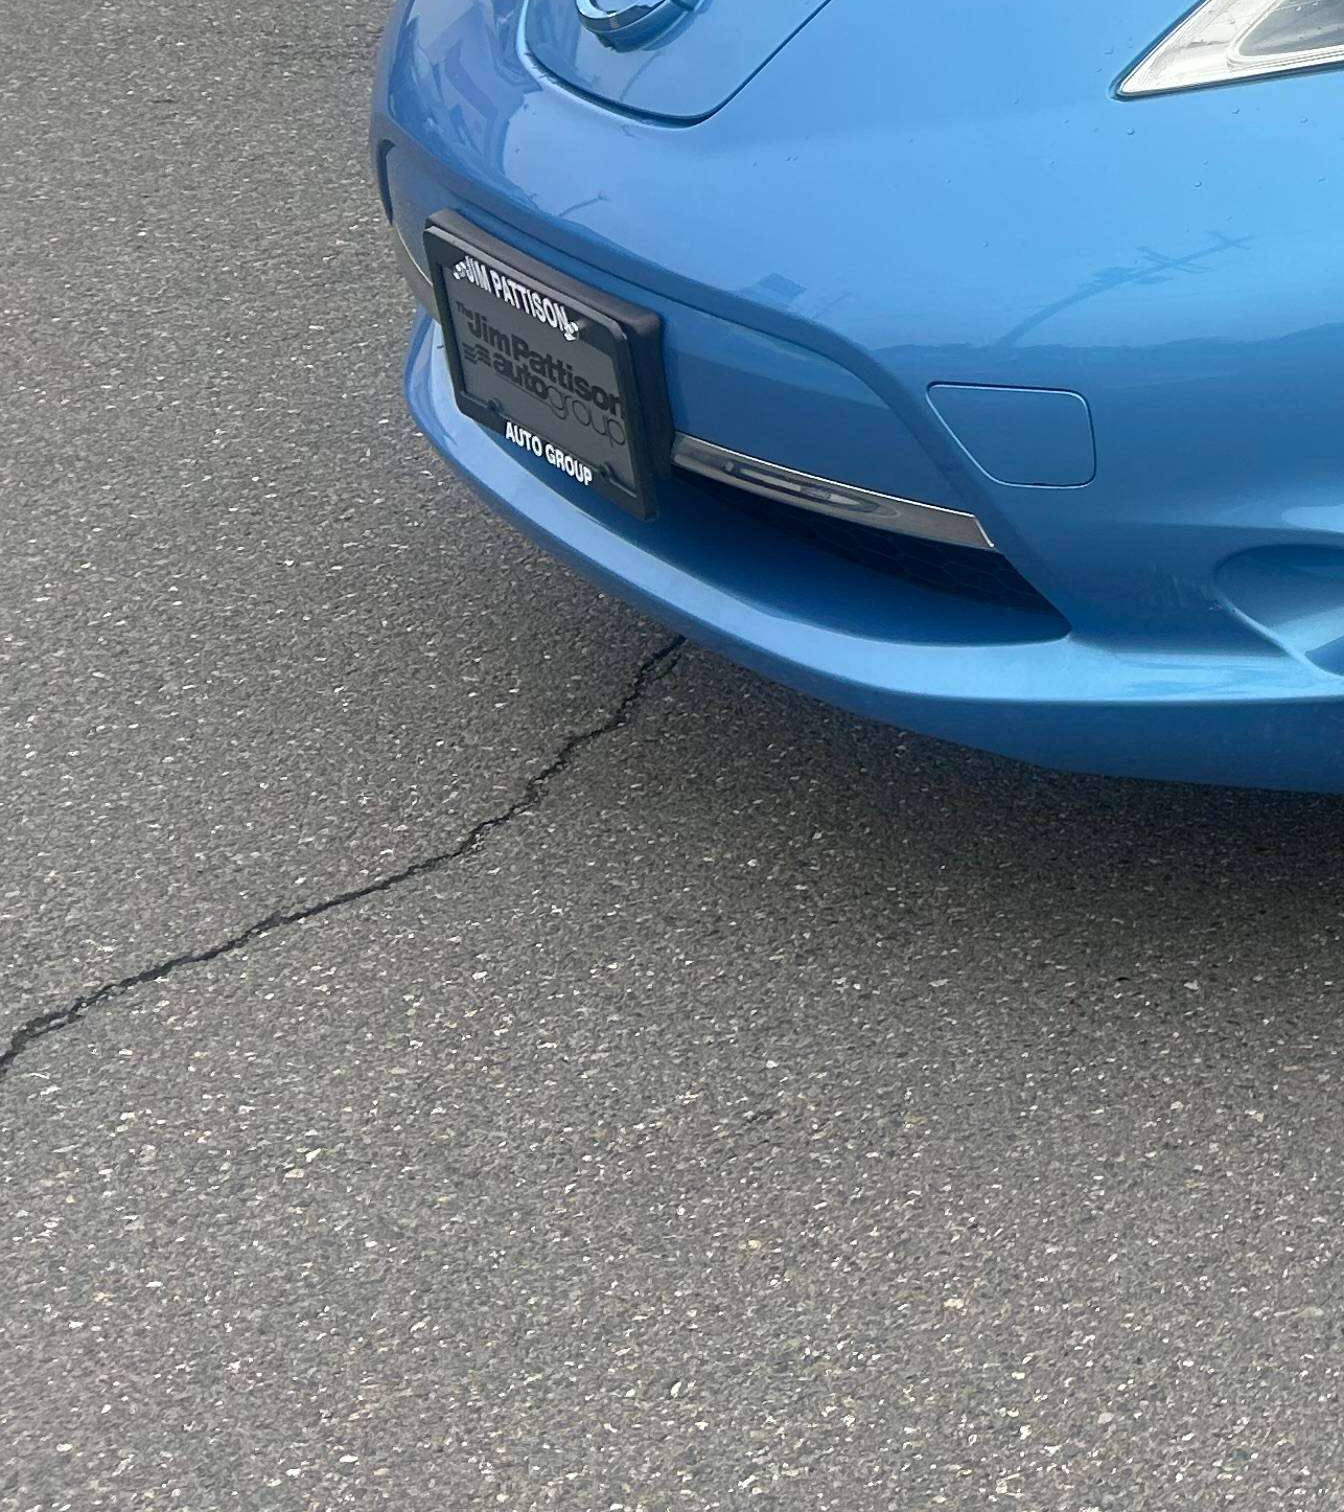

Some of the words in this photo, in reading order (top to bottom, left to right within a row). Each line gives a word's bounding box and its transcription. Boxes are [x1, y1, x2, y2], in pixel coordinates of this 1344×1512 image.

[465, 255, 493, 294] JIM
[491, 269, 569, 331] PATTISON
[505, 419, 544, 458] AUTO
[544, 443, 594, 486] GROUP
